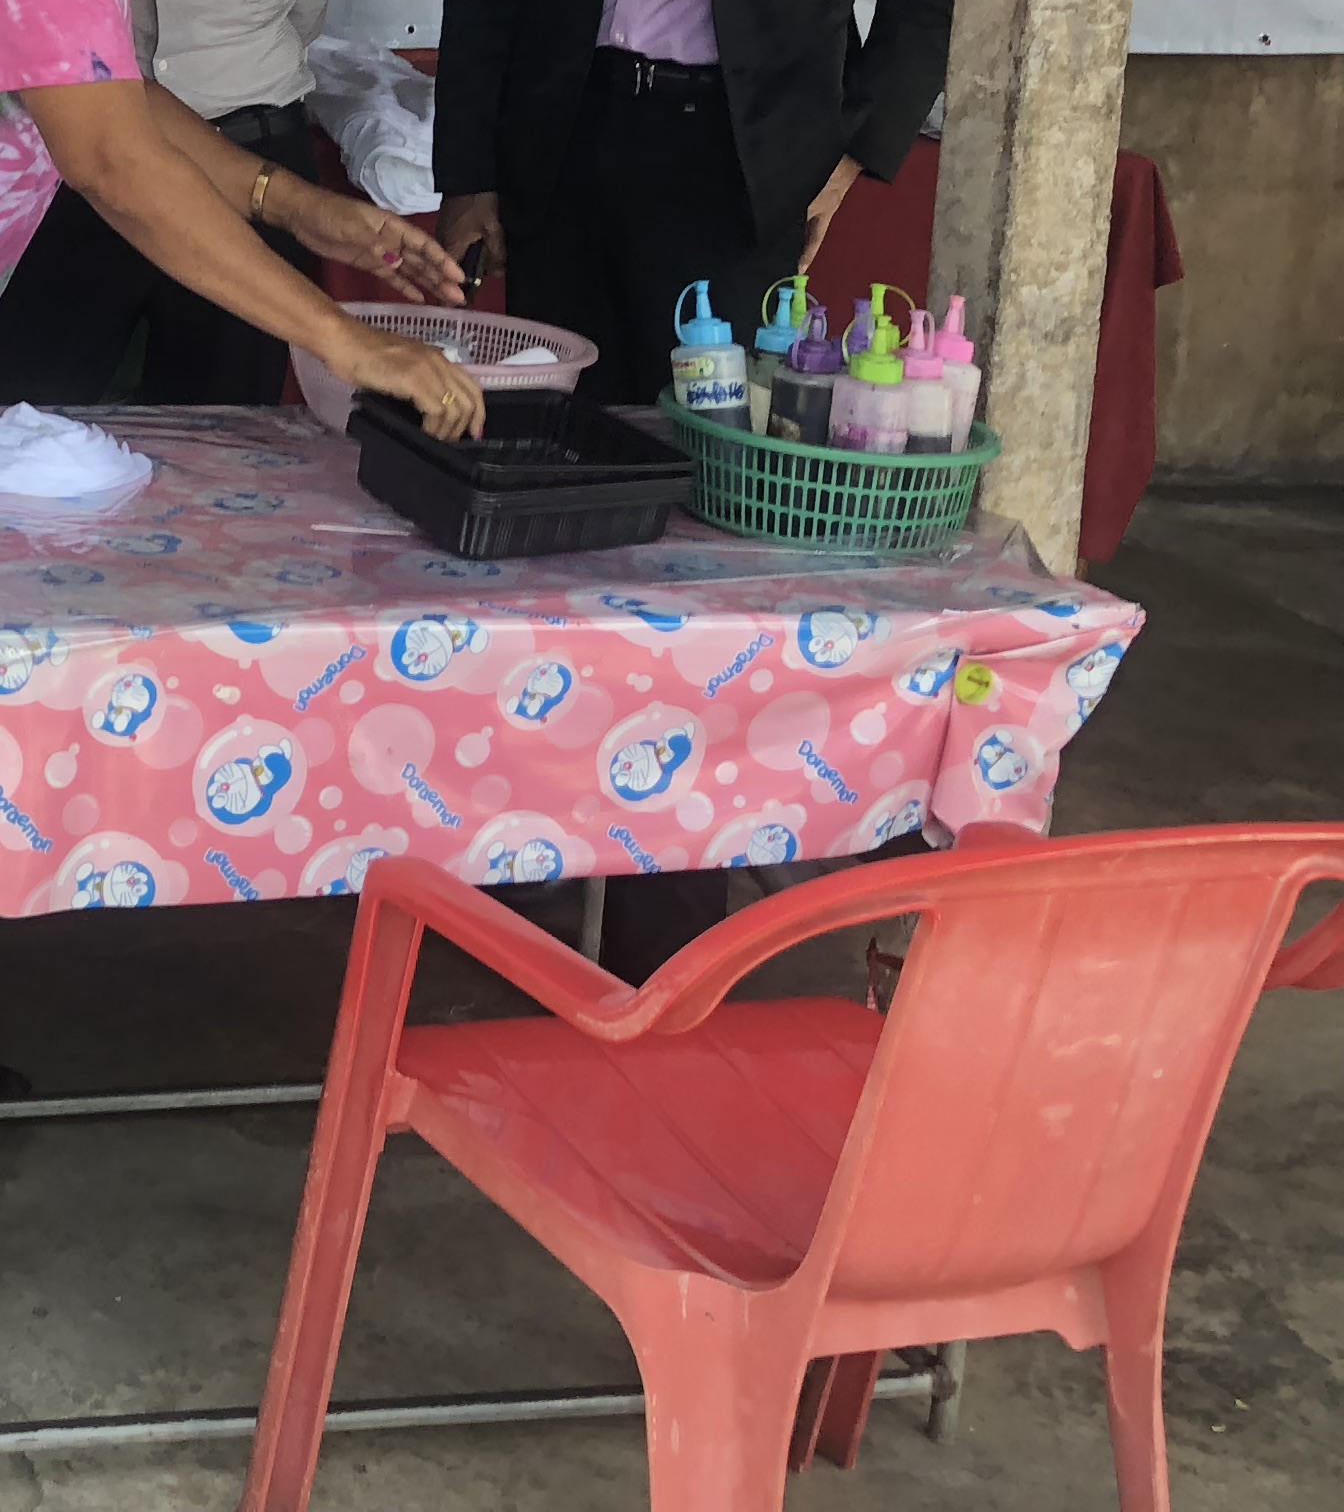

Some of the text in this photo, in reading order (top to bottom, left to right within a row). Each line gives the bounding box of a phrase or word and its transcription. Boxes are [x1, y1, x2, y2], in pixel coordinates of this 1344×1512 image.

[293, 645, 366, 712] Doraemon
[702, 633, 774, 698] Doraemon
[401, 762, 462, 829] Doraemon
[797, 739, 859, 804] Doraemon
[204, 848, 260, 902] oraemon
